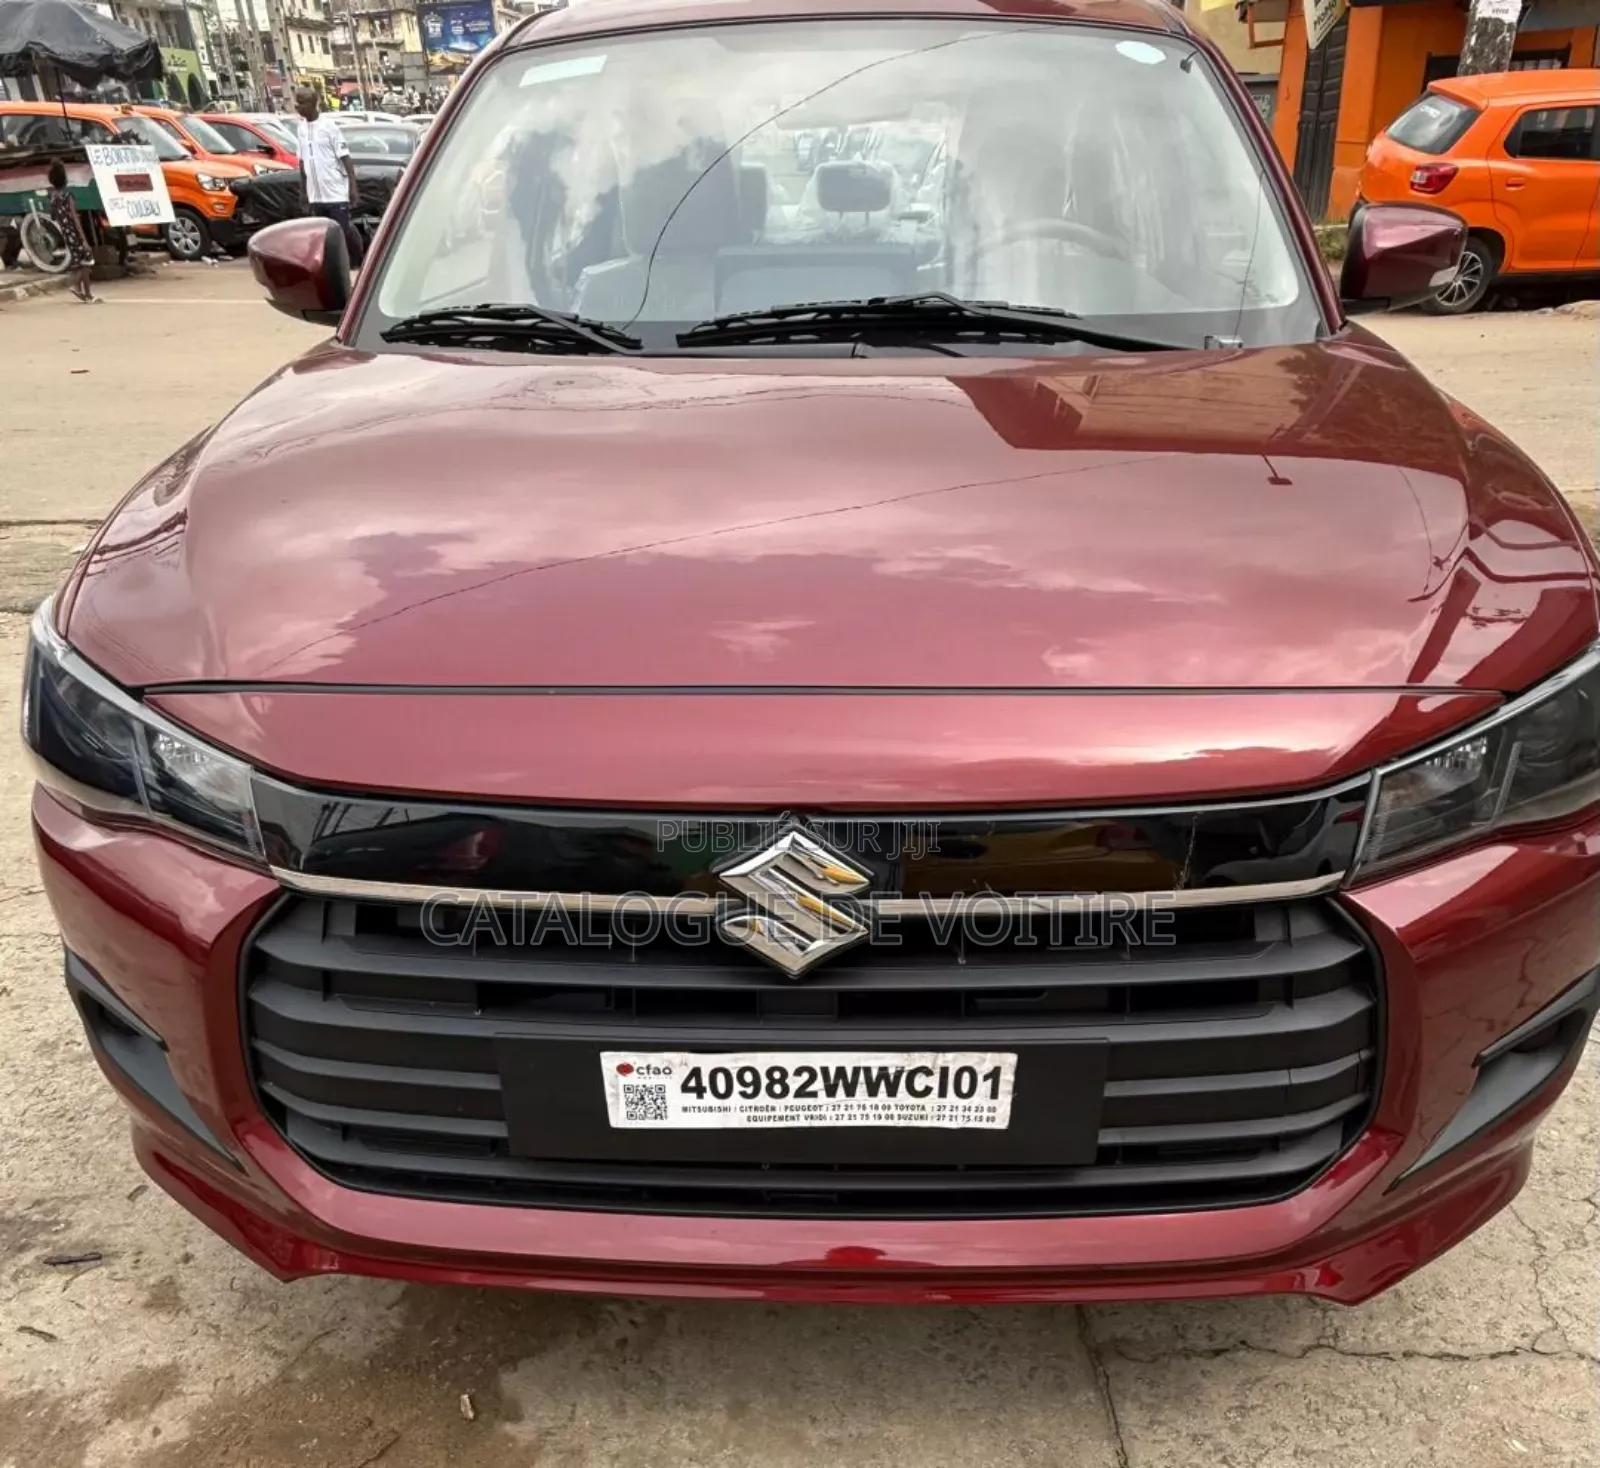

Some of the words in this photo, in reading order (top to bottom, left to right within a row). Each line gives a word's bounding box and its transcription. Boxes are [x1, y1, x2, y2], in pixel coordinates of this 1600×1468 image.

[636, 1064, 673, 1075] cfao
[680, 1065, 1002, 1101] 40982WWCI01
[681, 1105, 731, 1113] MITSUBISHI
[739, 1104, 776, 1112] CITROËN
[784, 1104, 823, 1112] PEUGEOT
[895, 1104, 926, 1112] TOYOTA
[746, 1114, 800, 1122] EQUIPEMENT
